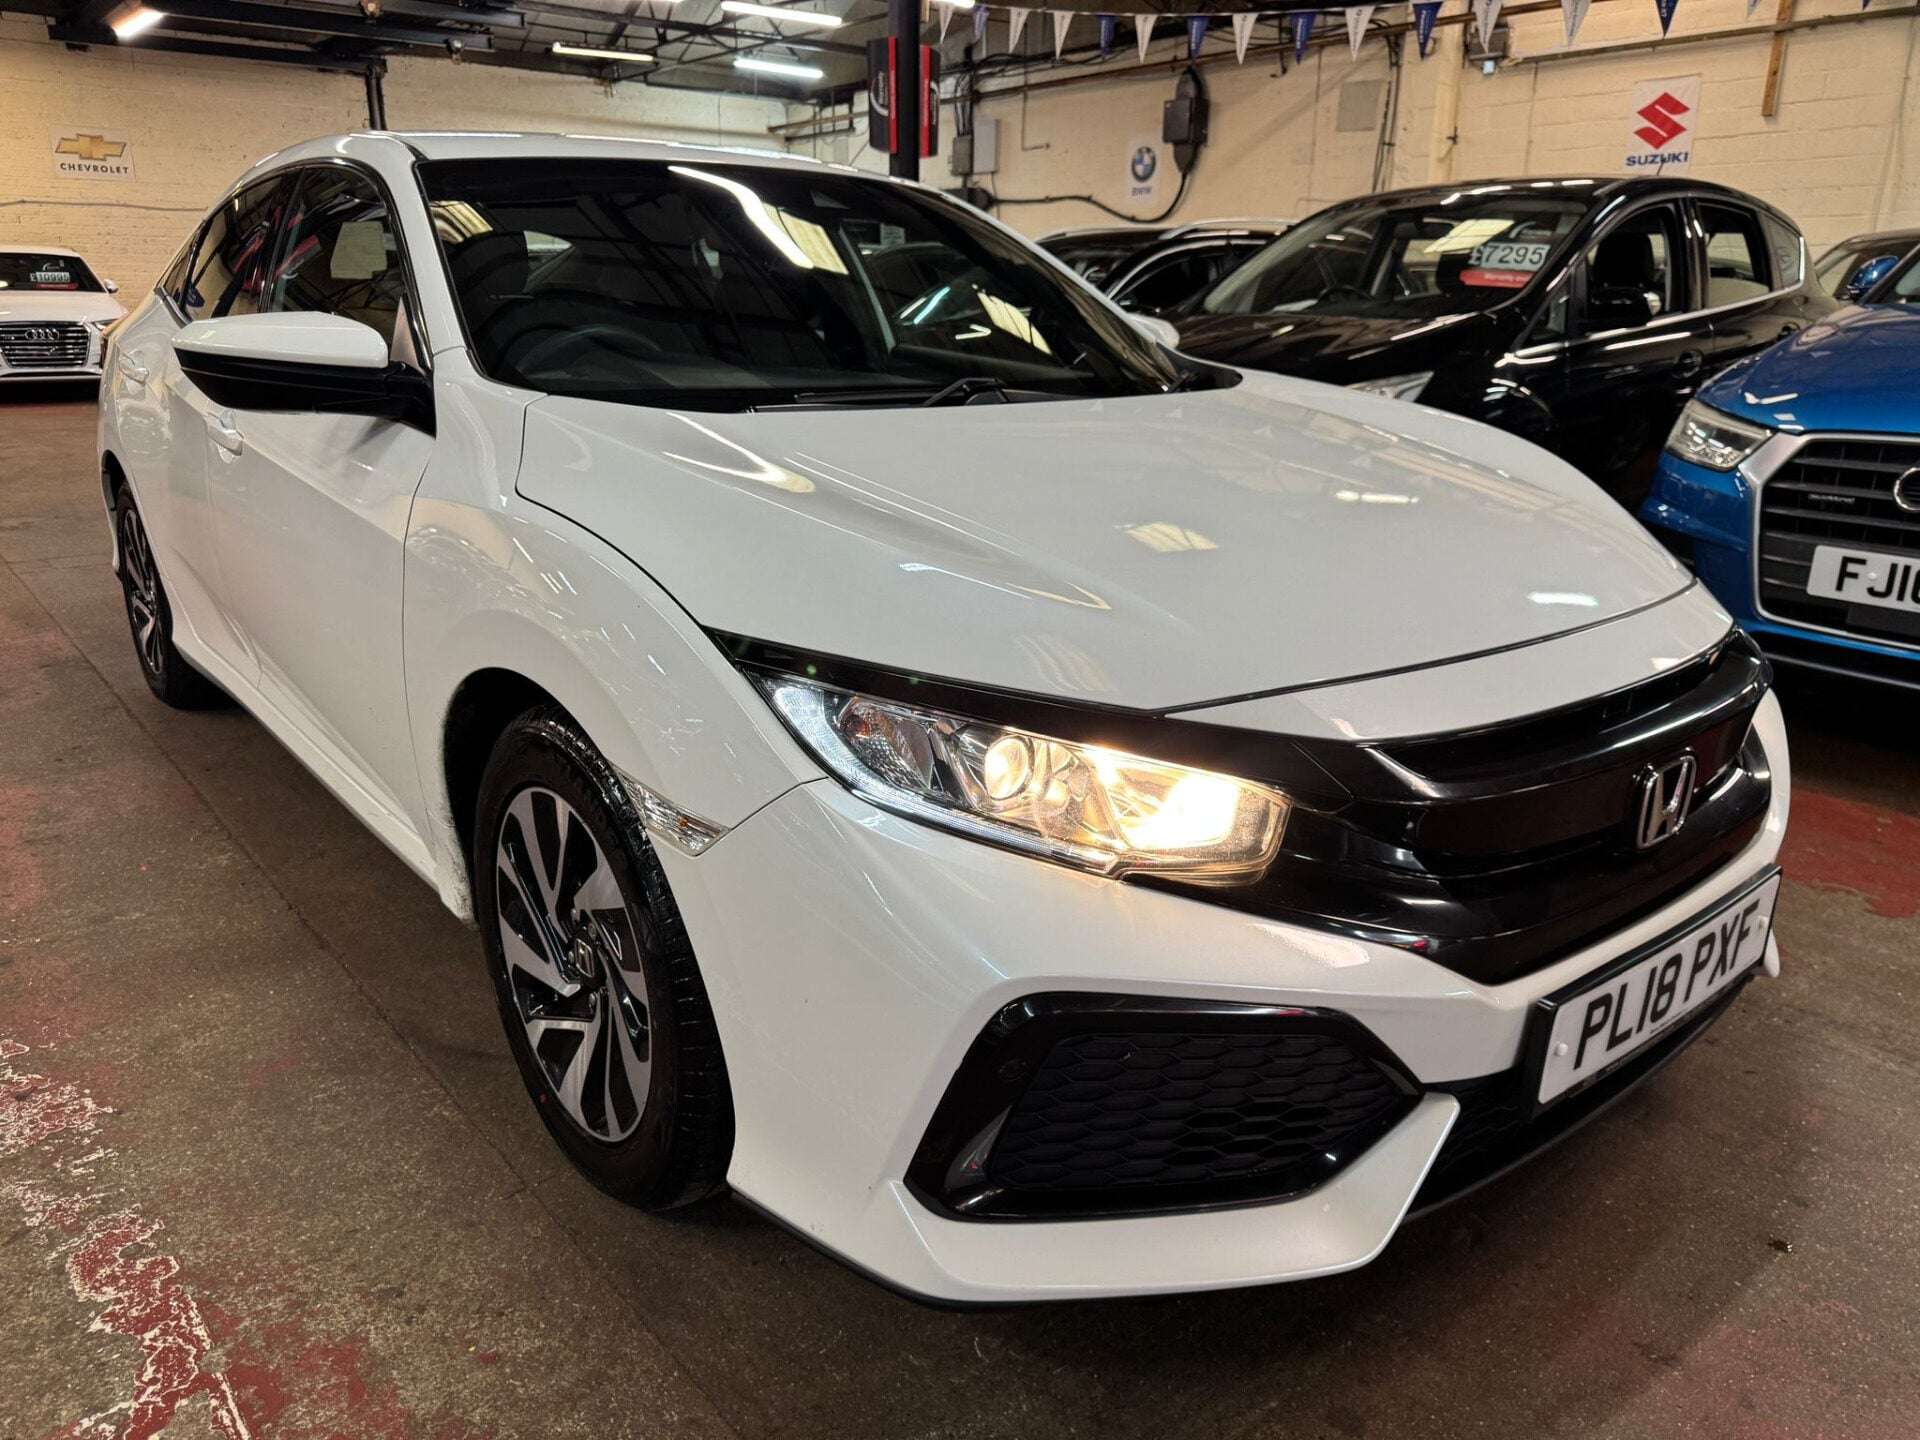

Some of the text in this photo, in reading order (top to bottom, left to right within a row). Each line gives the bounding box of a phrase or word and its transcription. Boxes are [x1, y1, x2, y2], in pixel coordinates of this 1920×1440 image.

[60, 162, 129, 174] CHEVROLET
[1625, 151, 1689, 167] SUZUKI
[1468, 244, 1546, 265] £7295
[1573, 899, 1760, 1071] PL18 PXF
